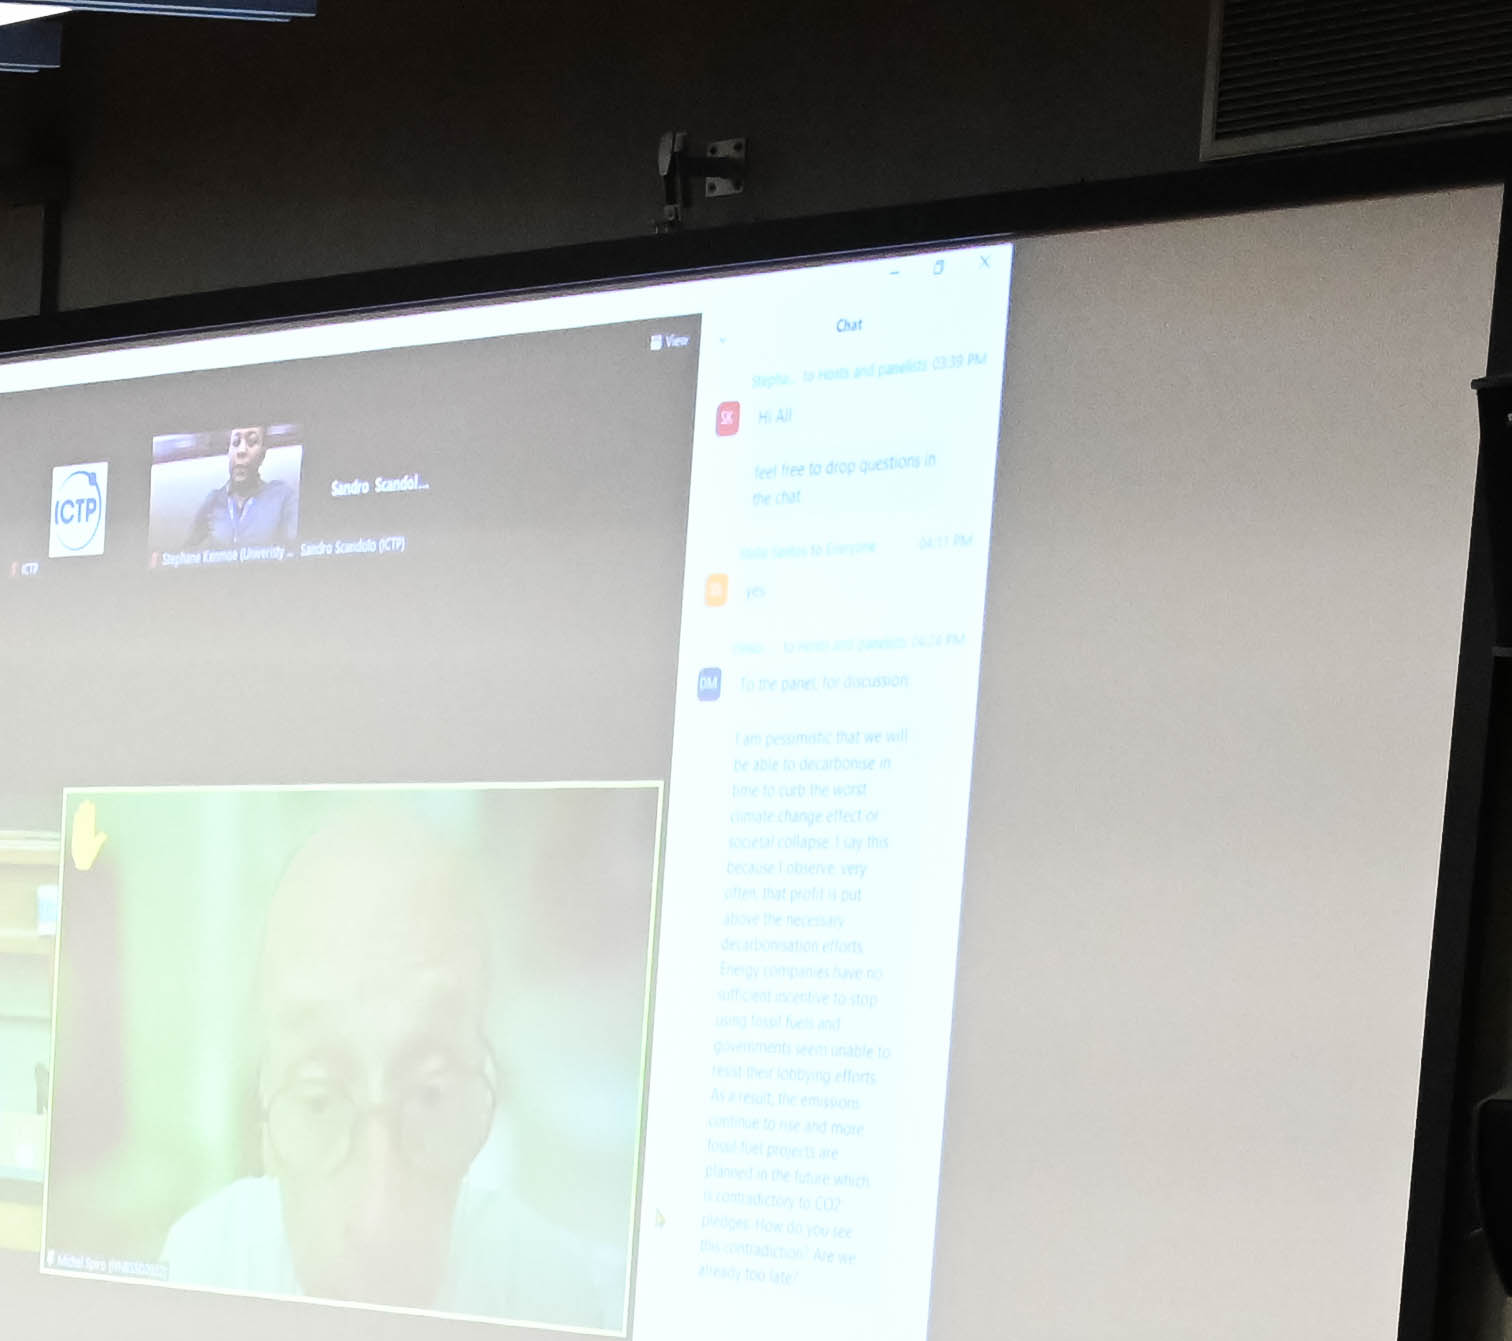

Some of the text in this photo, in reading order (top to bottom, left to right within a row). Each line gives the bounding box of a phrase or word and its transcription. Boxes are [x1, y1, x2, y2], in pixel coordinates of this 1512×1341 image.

[836, 318, 863, 332] Chat
[331, 479, 370, 496] Sandro
[54, 498, 97, 525] ICTP
